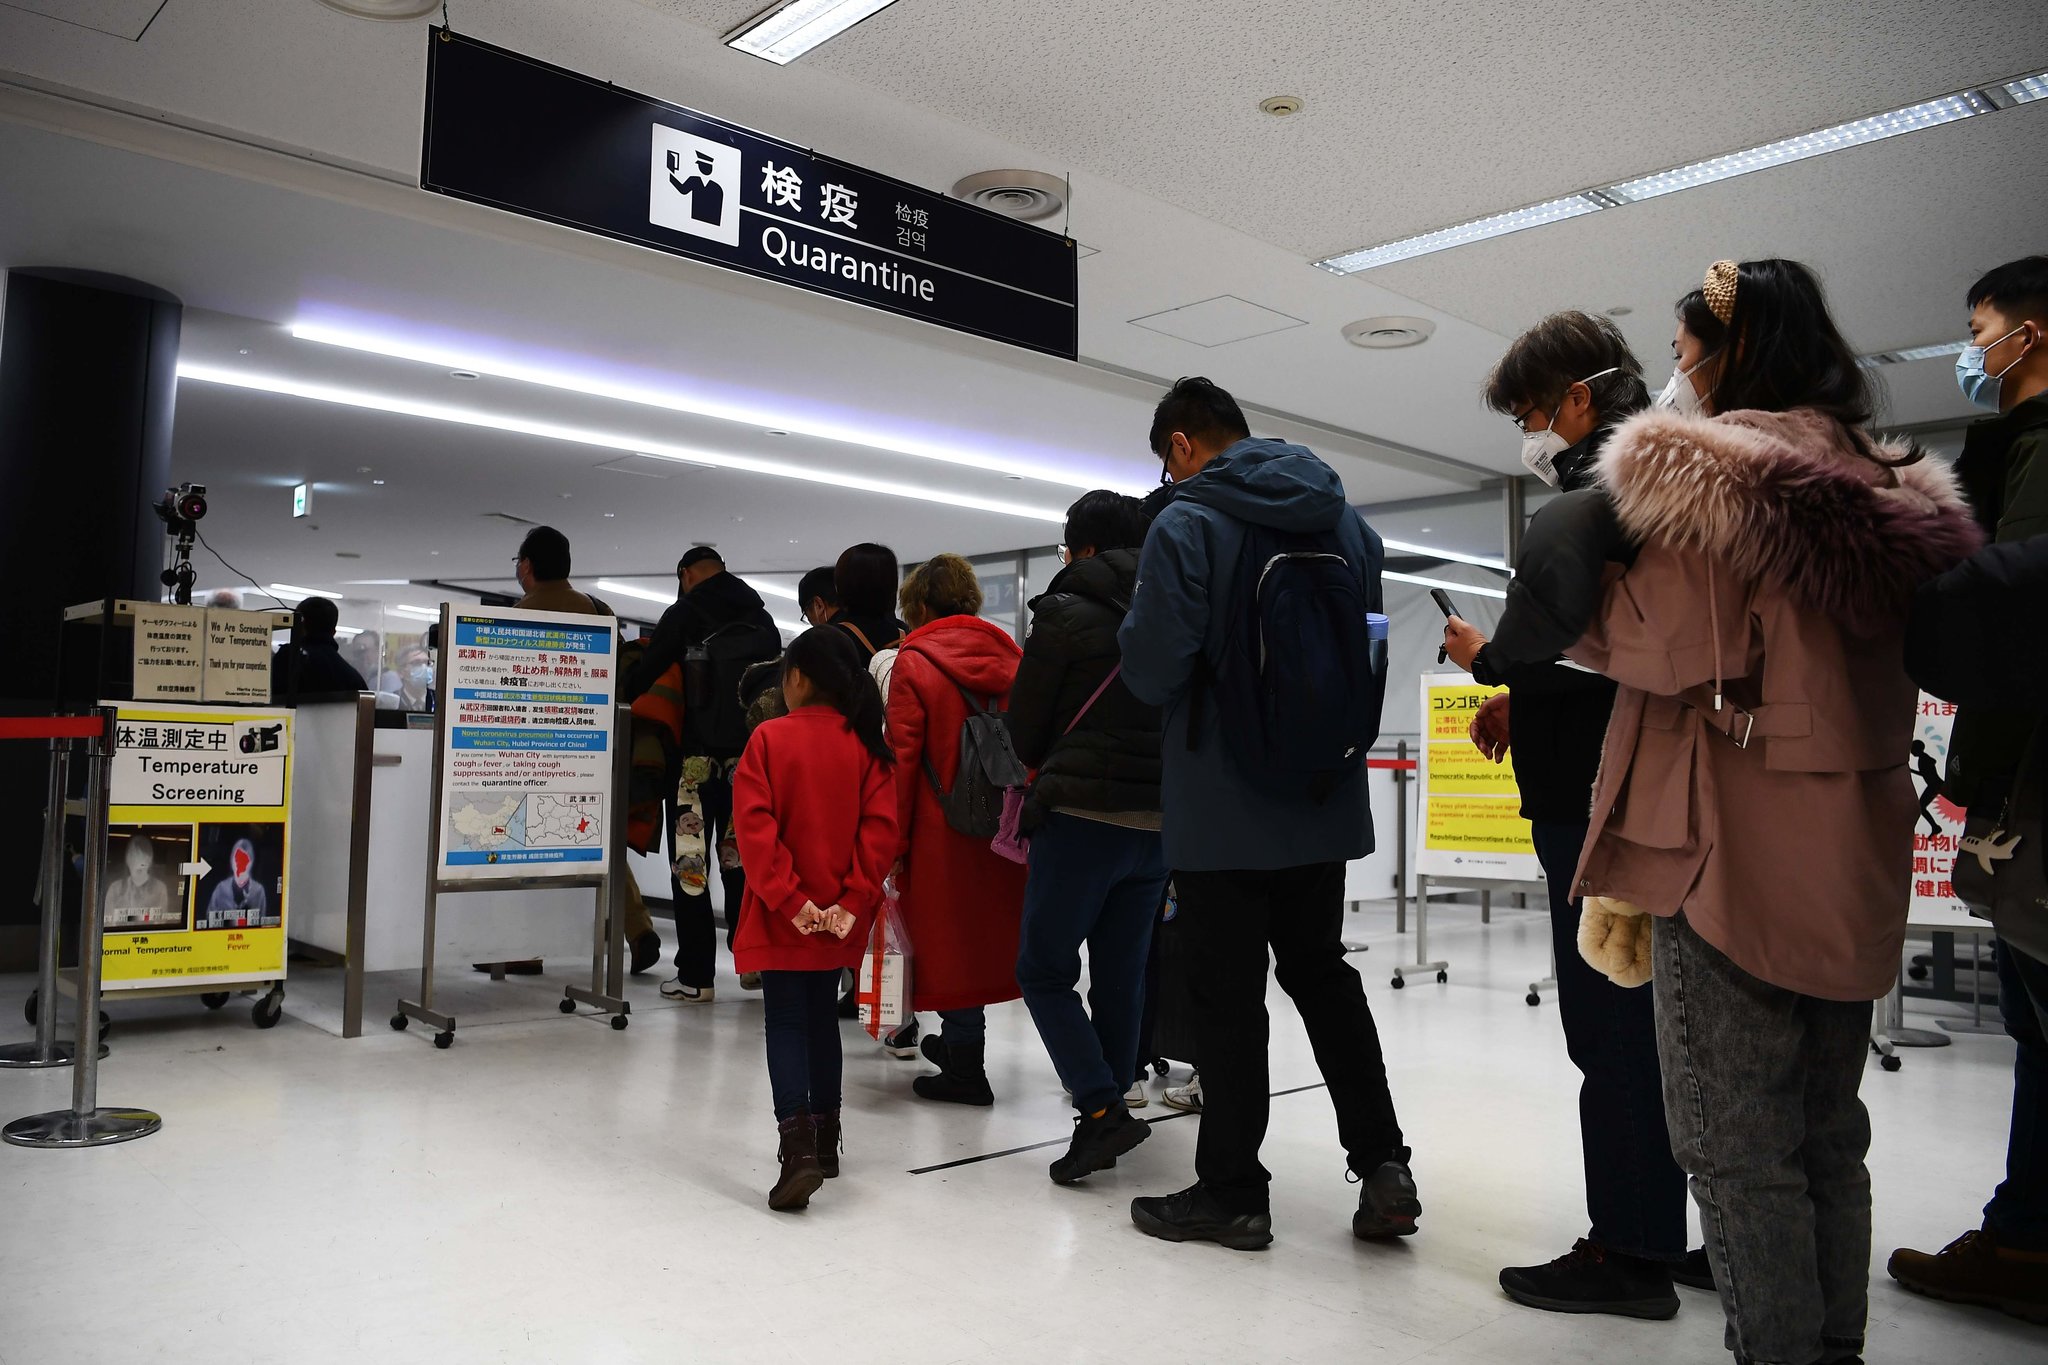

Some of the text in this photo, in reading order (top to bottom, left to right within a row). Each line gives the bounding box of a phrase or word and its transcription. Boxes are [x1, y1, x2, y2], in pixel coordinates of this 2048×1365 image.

[761, 160, 858, 229] 検疫
[895, 201, 929, 230] 检疫
[896, 226, 926, 251] 검역
[762, 226, 935, 301] Quarantine
[211, 621, 268, 636] We Are Screening
[211, 634, 267, 647] Your Temperature.
[458, 649, 486, 660] 武漢市
[210, 658, 221, 668] Thank
[237, 662, 245, 670] your
[116, 726, 226, 749] 体温測定中
[481, 731, 517, 739] coronavirus
[518, 732, 553, 740] pneumonia
[531, 740, 558, 748] Province
[498, 751, 524, 759] Wuhan
[526, 751, 541, 760] City
[138, 756, 258, 776] Temperature
[453, 761, 477, 769] cough
[513, 761, 536, 769] taking
[538, 761, 561, 769] cough
[453, 770, 503, 778] suppressants
[504, 770, 530, 778] and/or
[152, 783, 244, 803] Screening
[136, 945, 192, 955] Temperature
[227, 943, 250, 951] Fever
